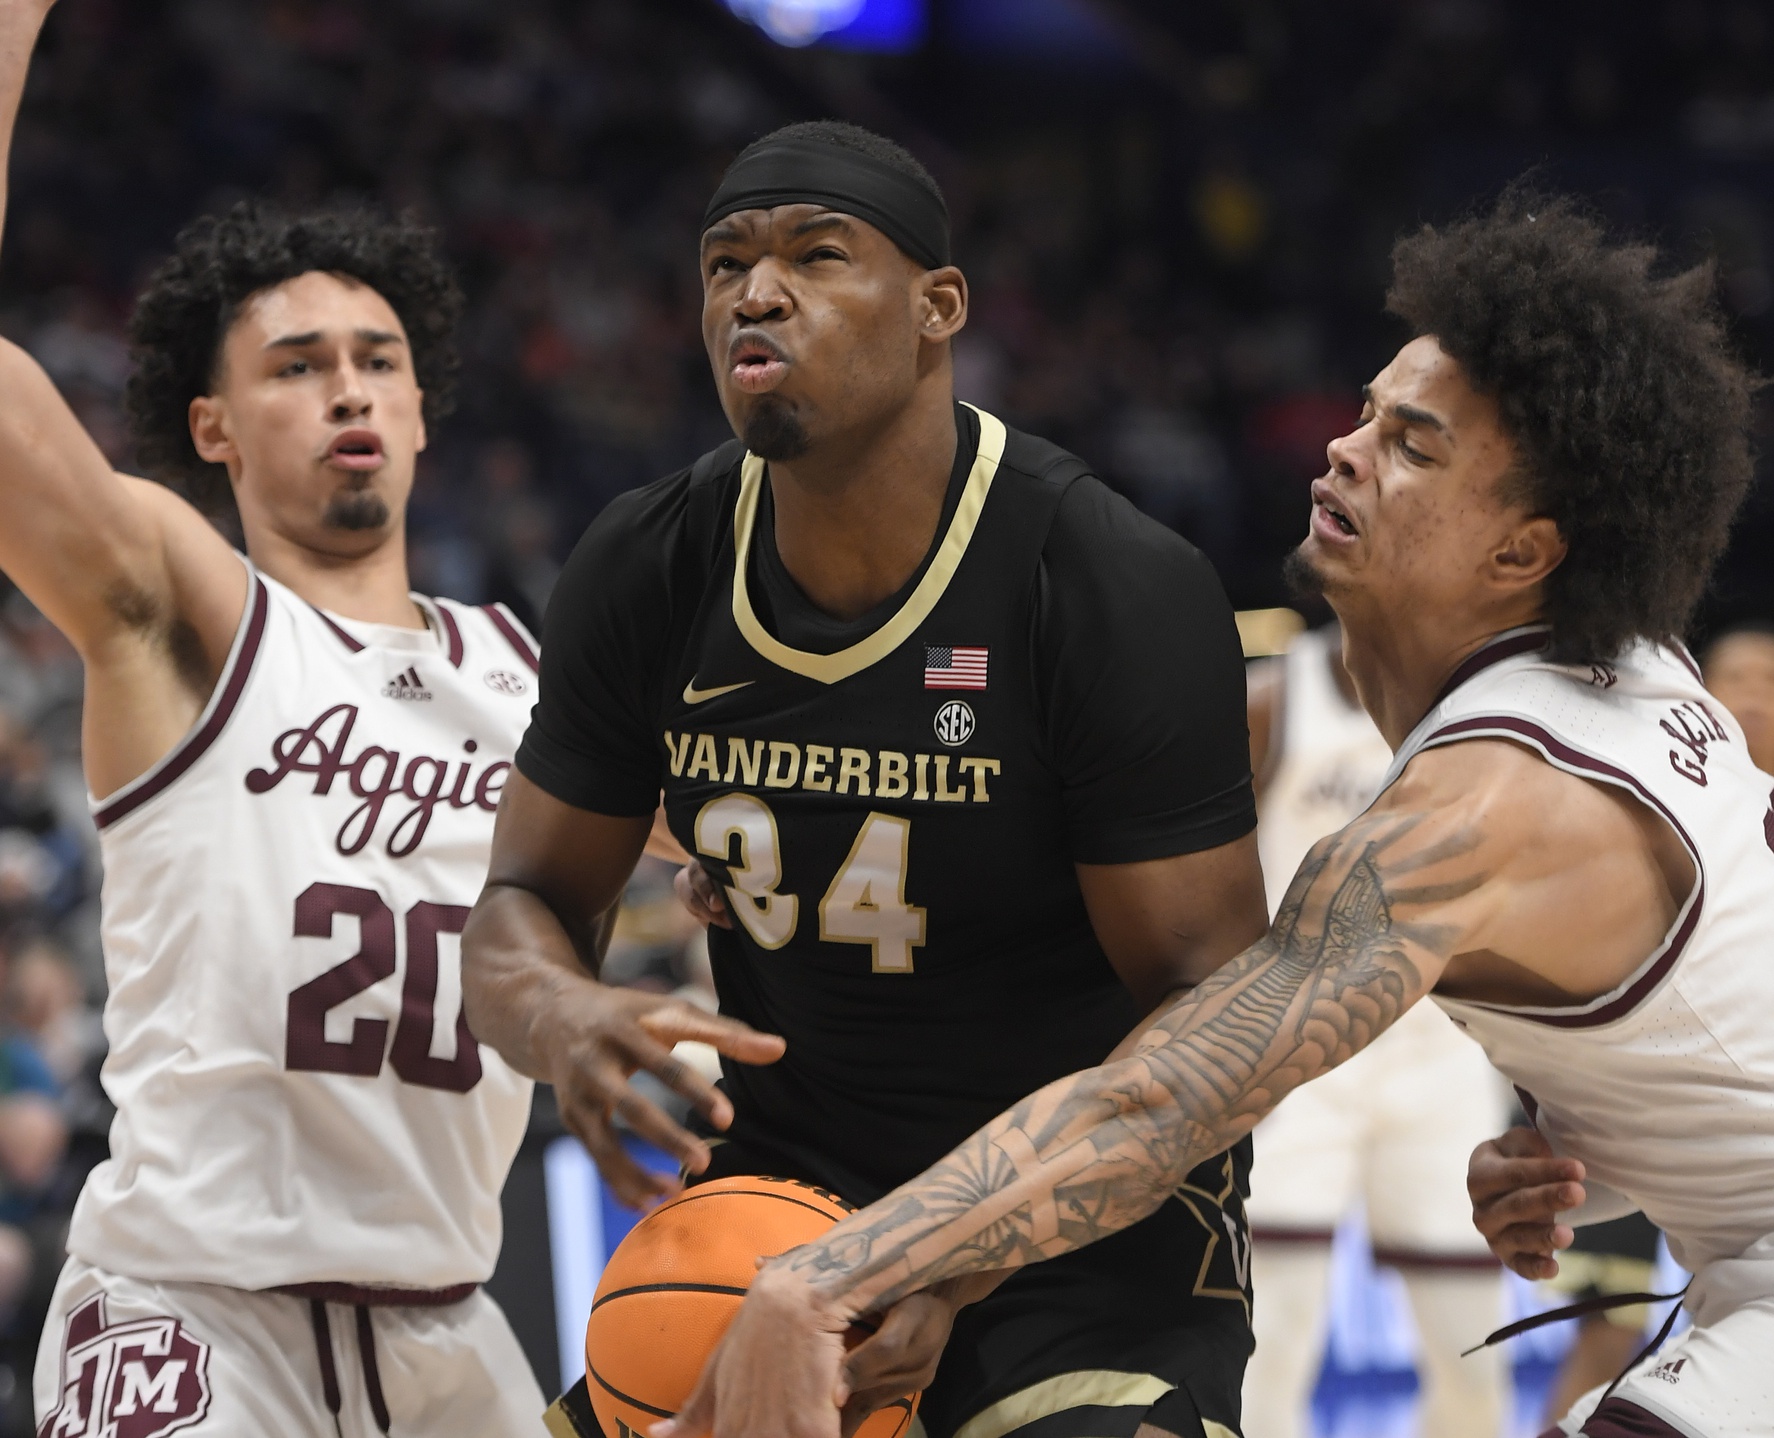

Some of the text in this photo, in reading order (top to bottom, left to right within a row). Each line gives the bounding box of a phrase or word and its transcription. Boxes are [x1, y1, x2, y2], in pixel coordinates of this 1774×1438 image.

[245, 704, 511, 858] Aggie
[664, 730, 1001, 803] VANDERBILT
[937, 704, 972, 742] SEC
[694, 792, 928, 974] 34
[285, 882, 482, 1094] 20
